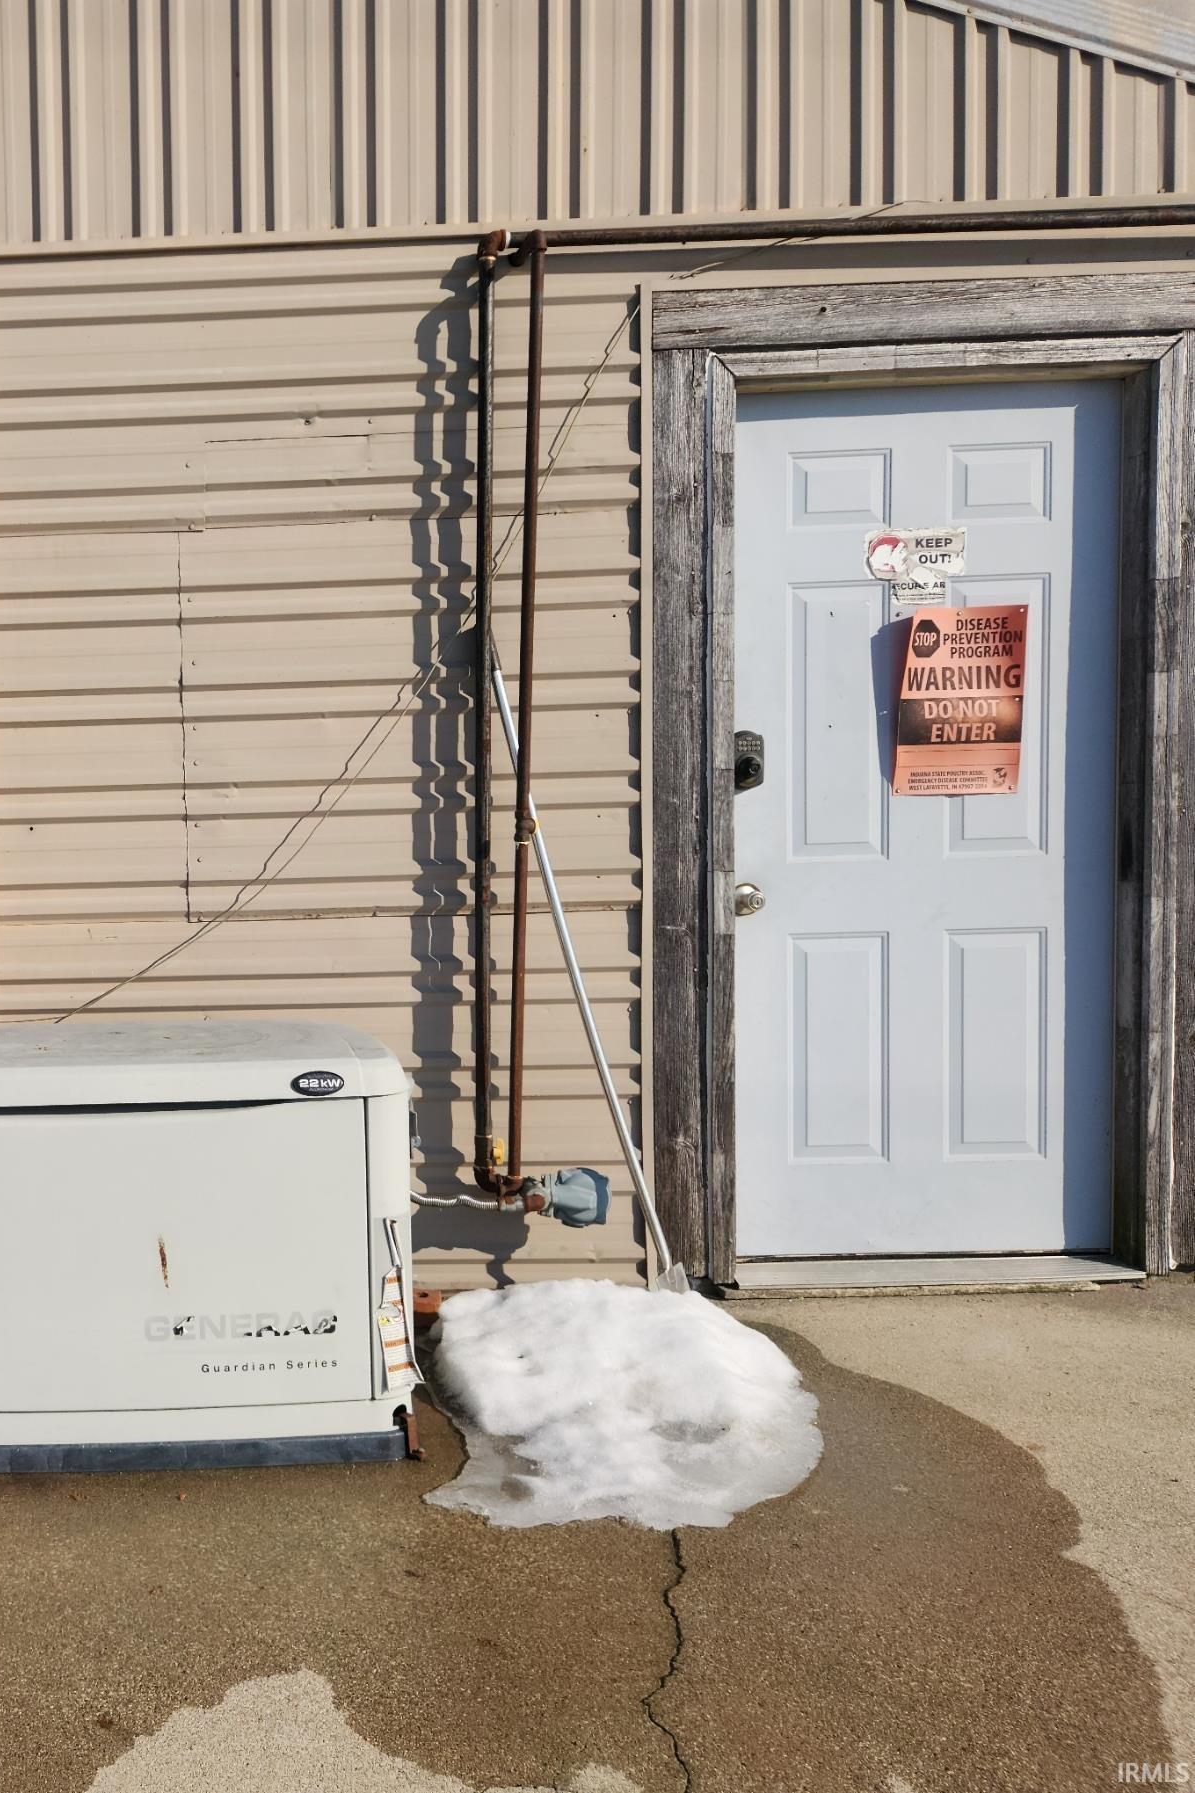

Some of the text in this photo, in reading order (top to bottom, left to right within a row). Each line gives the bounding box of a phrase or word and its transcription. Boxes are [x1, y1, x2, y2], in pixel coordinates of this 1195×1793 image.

[915, 538, 953, 548] KEEP
[918, 553, 951, 564] OUT!
[956, 617, 1009, 631] DISEASE
[914, 632, 937, 646] STOP
[943, 630, 1023, 645] PREVENTION
[950, 645, 1013, 659] PROGRAM
[907, 664, 1021, 692] WARNING
[924, 699, 1000, 719] DO NOT
[930, 722, 997, 742] ENTER
[201, 1359, 338, 1373] Guardian Series
